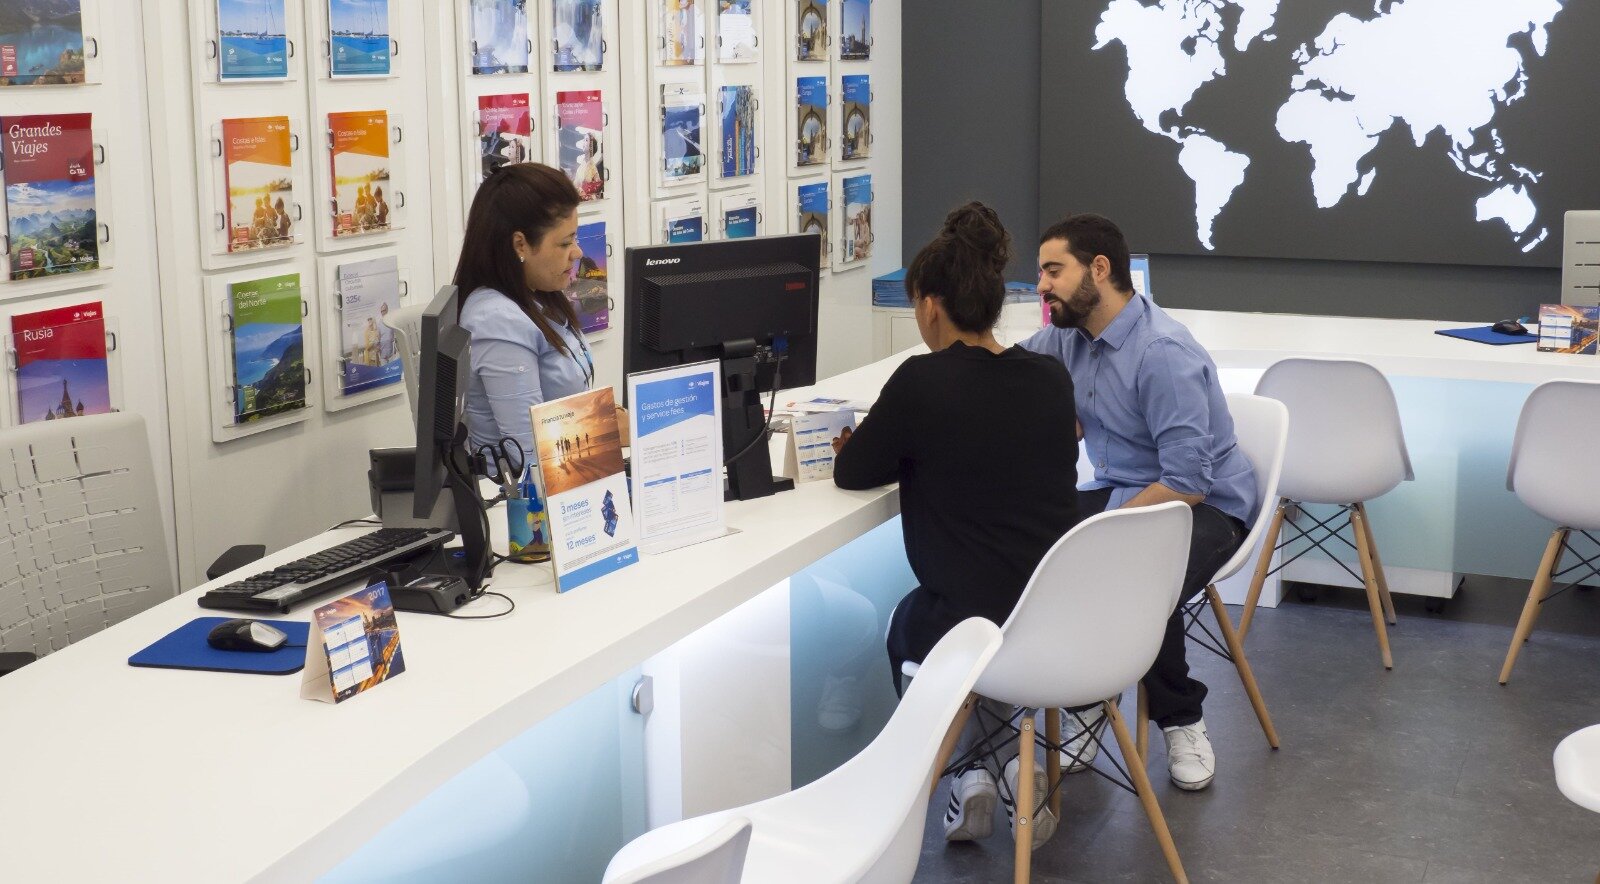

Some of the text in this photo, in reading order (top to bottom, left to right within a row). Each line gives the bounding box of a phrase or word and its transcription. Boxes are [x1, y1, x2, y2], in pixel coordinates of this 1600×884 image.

[9, 122, 62, 139] Grandes
[337, 130, 352, 138] Costas
[232, 137, 250, 145] Costas
[254, 136, 266, 144] Islas
[12, 141, 48, 157] Viajes
[646, 257, 681, 266] lenovo
[236, 290, 259, 300] Costas
[345, 294, 361, 305] 325€
[238, 298, 267, 310] del Norte
[83, 310, 97, 318] Viajes
[24, 327, 54, 342] Rusia
[641, 394, 698, 411] Gastos de gestión
[641, 406, 684, 423] y service fees
[560, 505, 566, 514] 3
[566, 499, 589, 512] meses
[566, 541, 574, 550] 12
[368, 587, 385, 601] 2017
